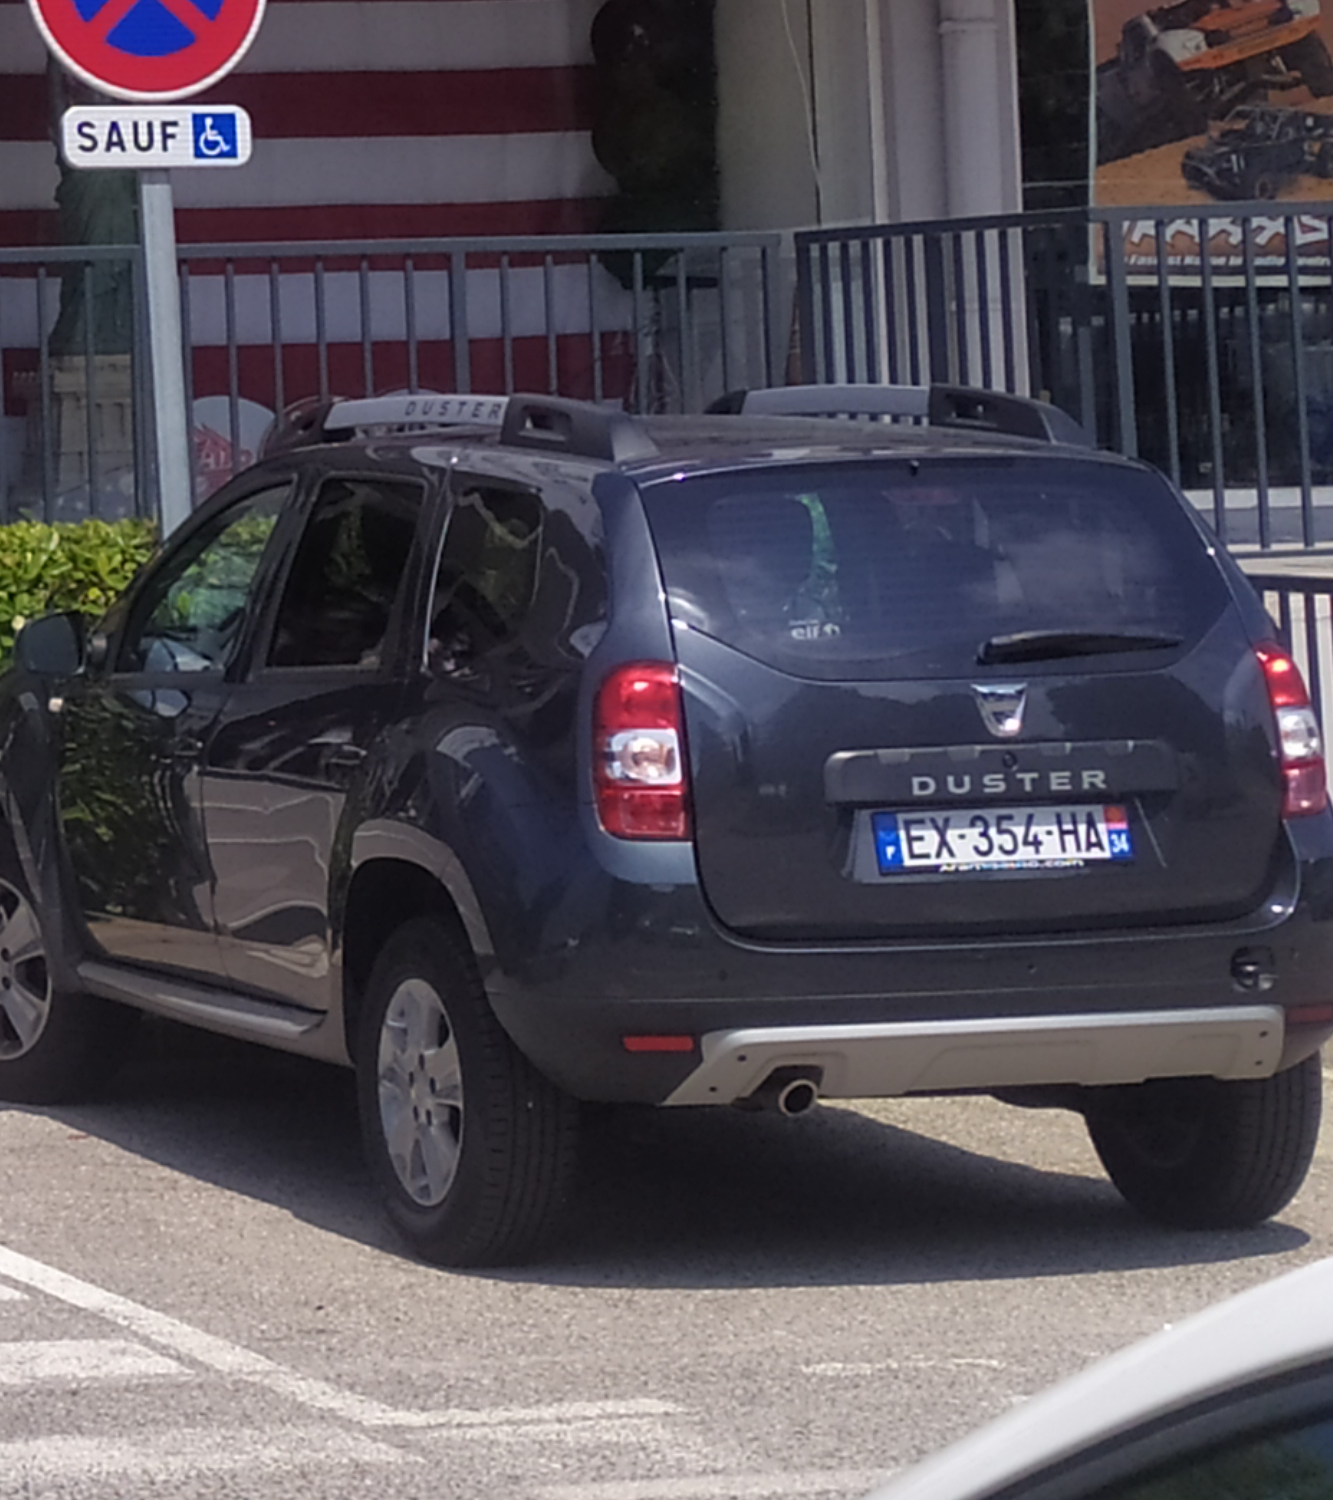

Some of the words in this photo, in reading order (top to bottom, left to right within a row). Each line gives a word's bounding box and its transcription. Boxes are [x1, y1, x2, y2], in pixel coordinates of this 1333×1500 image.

[77, 120, 179, 152] SAUF
[405, 401, 501, 420] DUSTER
[912, 770, 1108, 797] DUSTER
[1110, 833, 1130, 852] 34
